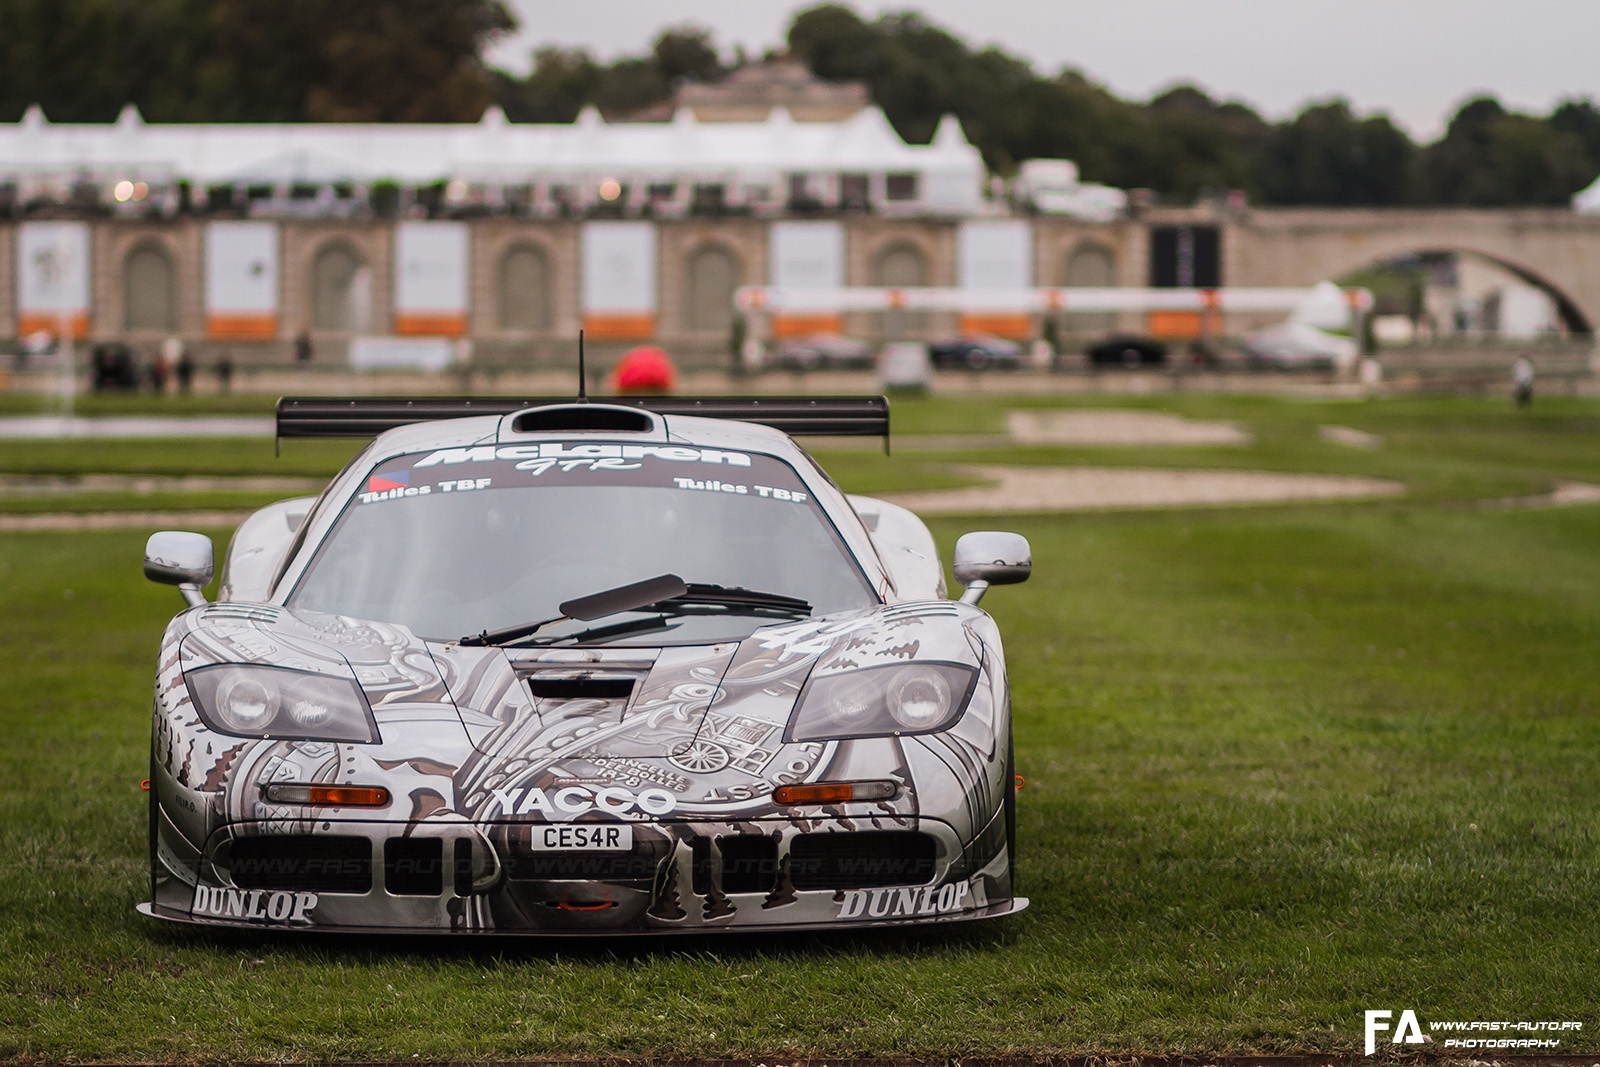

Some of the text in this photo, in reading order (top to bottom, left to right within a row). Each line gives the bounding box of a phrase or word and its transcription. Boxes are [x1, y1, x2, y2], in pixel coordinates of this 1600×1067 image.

[413, 443, 752, 468] McLaren
[515, 457, 643, 477] GTR
[358, 478, 492, 504] Tuiles TBF
[673, 477, 807, 502] Tuiles TBF
[492, 787, 677, 815] YACCO
[544, 828, 620, 848] CES4R
[193, 885, 318, 920] DUNLOP
[837, 880, 969, 918] DUNLOP
